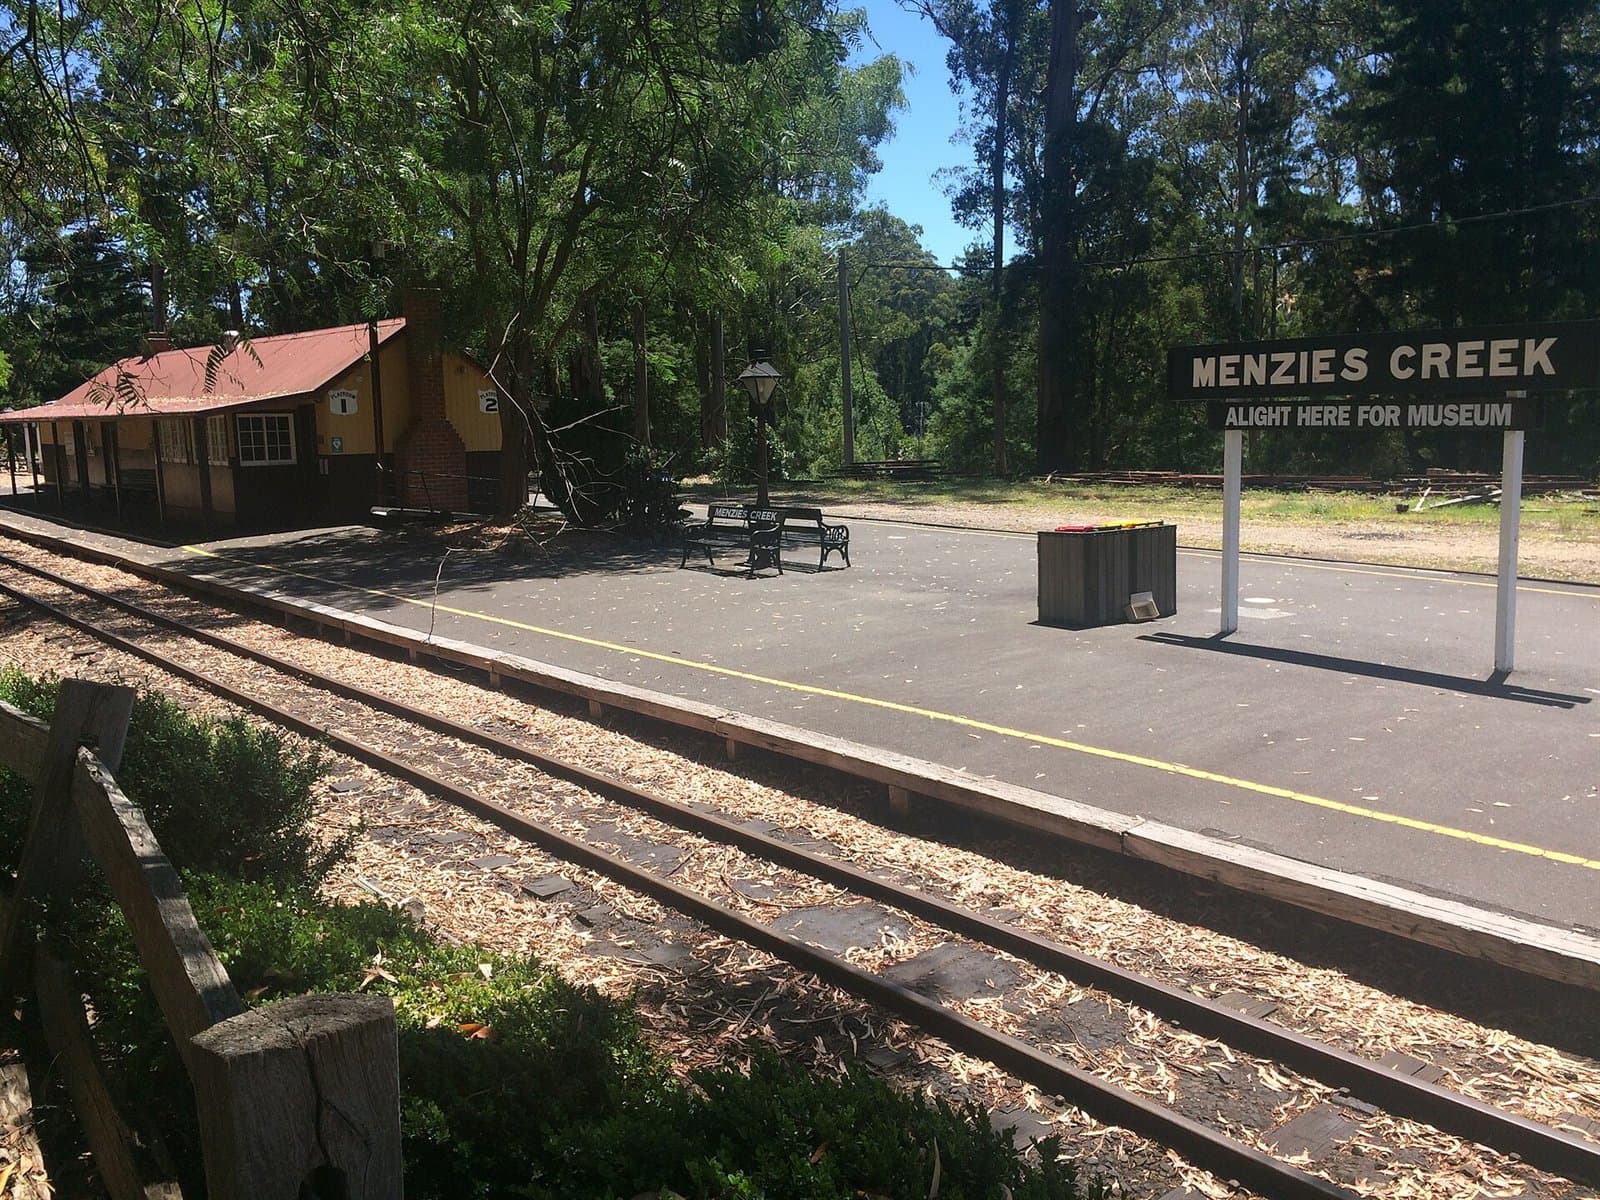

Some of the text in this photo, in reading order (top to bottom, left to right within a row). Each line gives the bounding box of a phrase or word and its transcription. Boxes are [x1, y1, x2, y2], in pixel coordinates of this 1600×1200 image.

[1192, 337, 1558, 388] MENZIES CREEK
[486, 398, 498, 411] 2
[1225, 403, 1512, 427] ALIGHT HERE FOR MUSEUM
[714, 508, 778, 521] MENZIES CREEK
